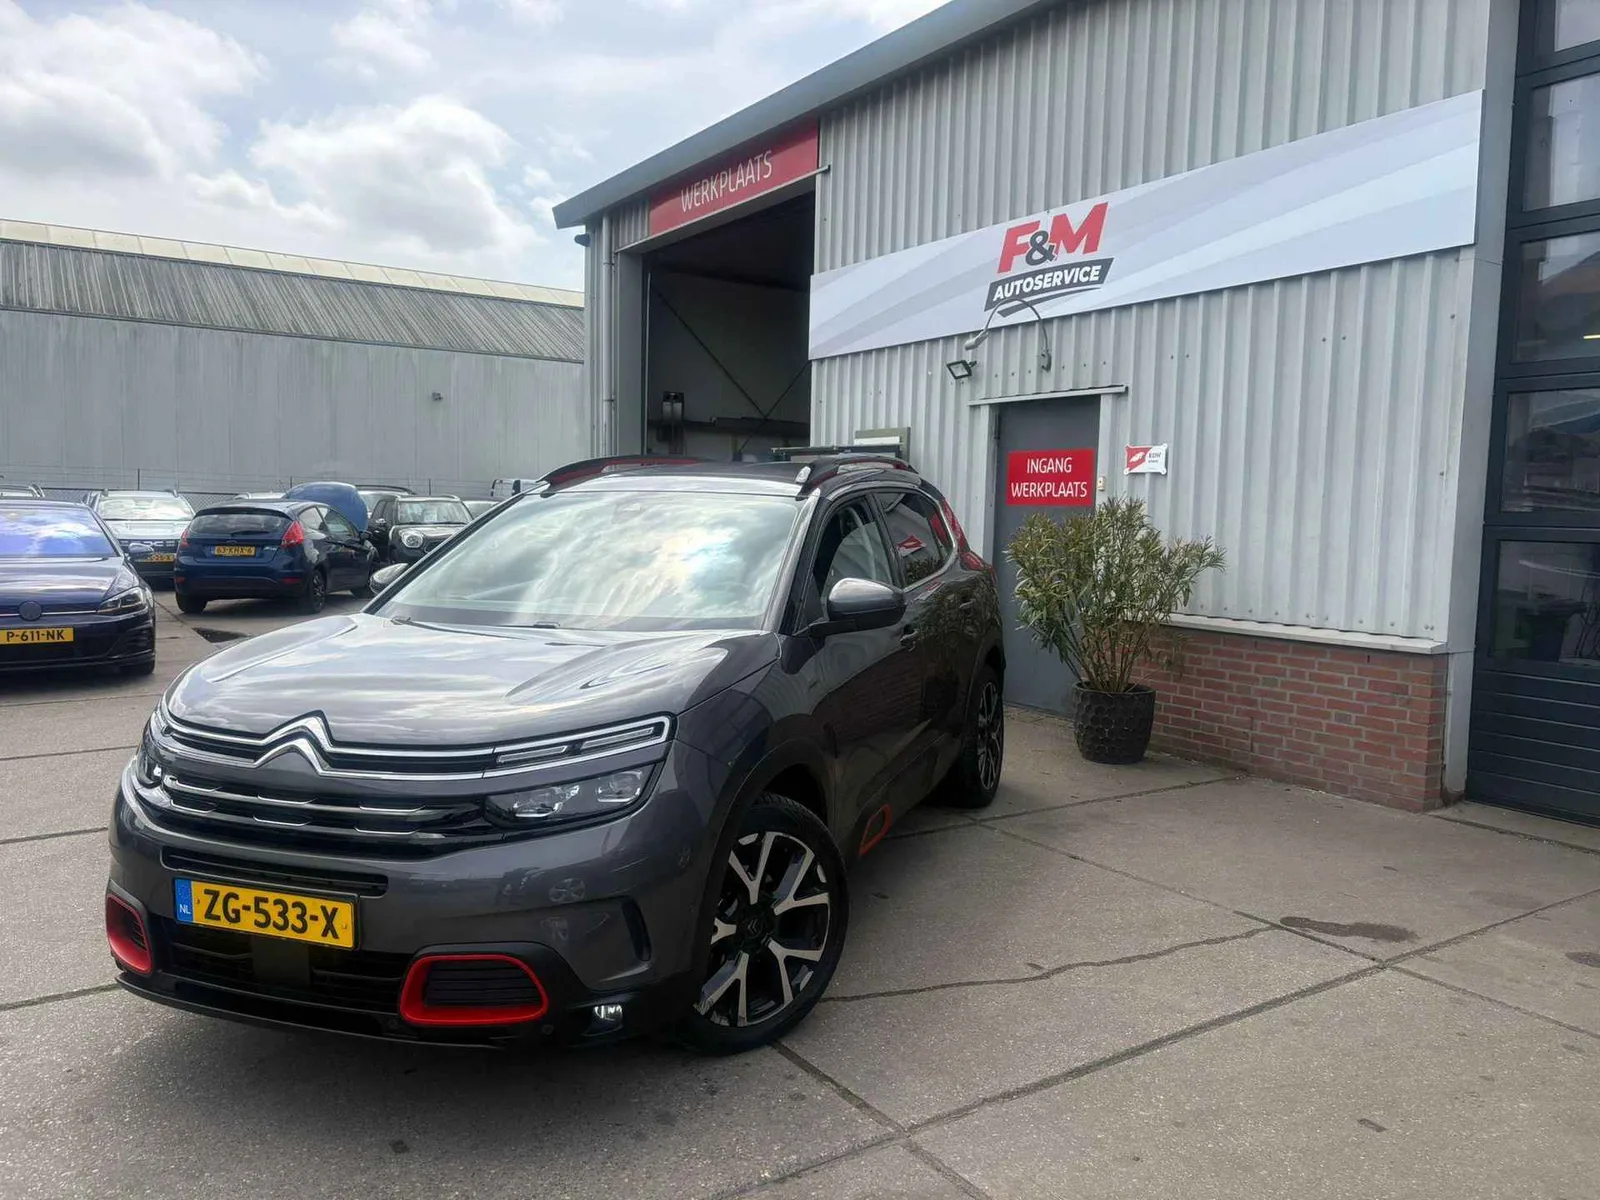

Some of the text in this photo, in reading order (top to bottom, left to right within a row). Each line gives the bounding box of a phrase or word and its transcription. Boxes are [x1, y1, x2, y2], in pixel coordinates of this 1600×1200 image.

[680, 150, 772, 213] WERKPLAATS
[997, 201, 1109, 274] F&M
[992, 264, 1102, 302] AUTOSERVICE
[1026, 456, 1073, 474] INGANG
[1010, 481, 1088, 498] WERKPLAATS
[6, 629, 65, 642] P-611-NK
[179, 904, 191, 915] NL
[203, 888, 340, 940] ZG-533-X
